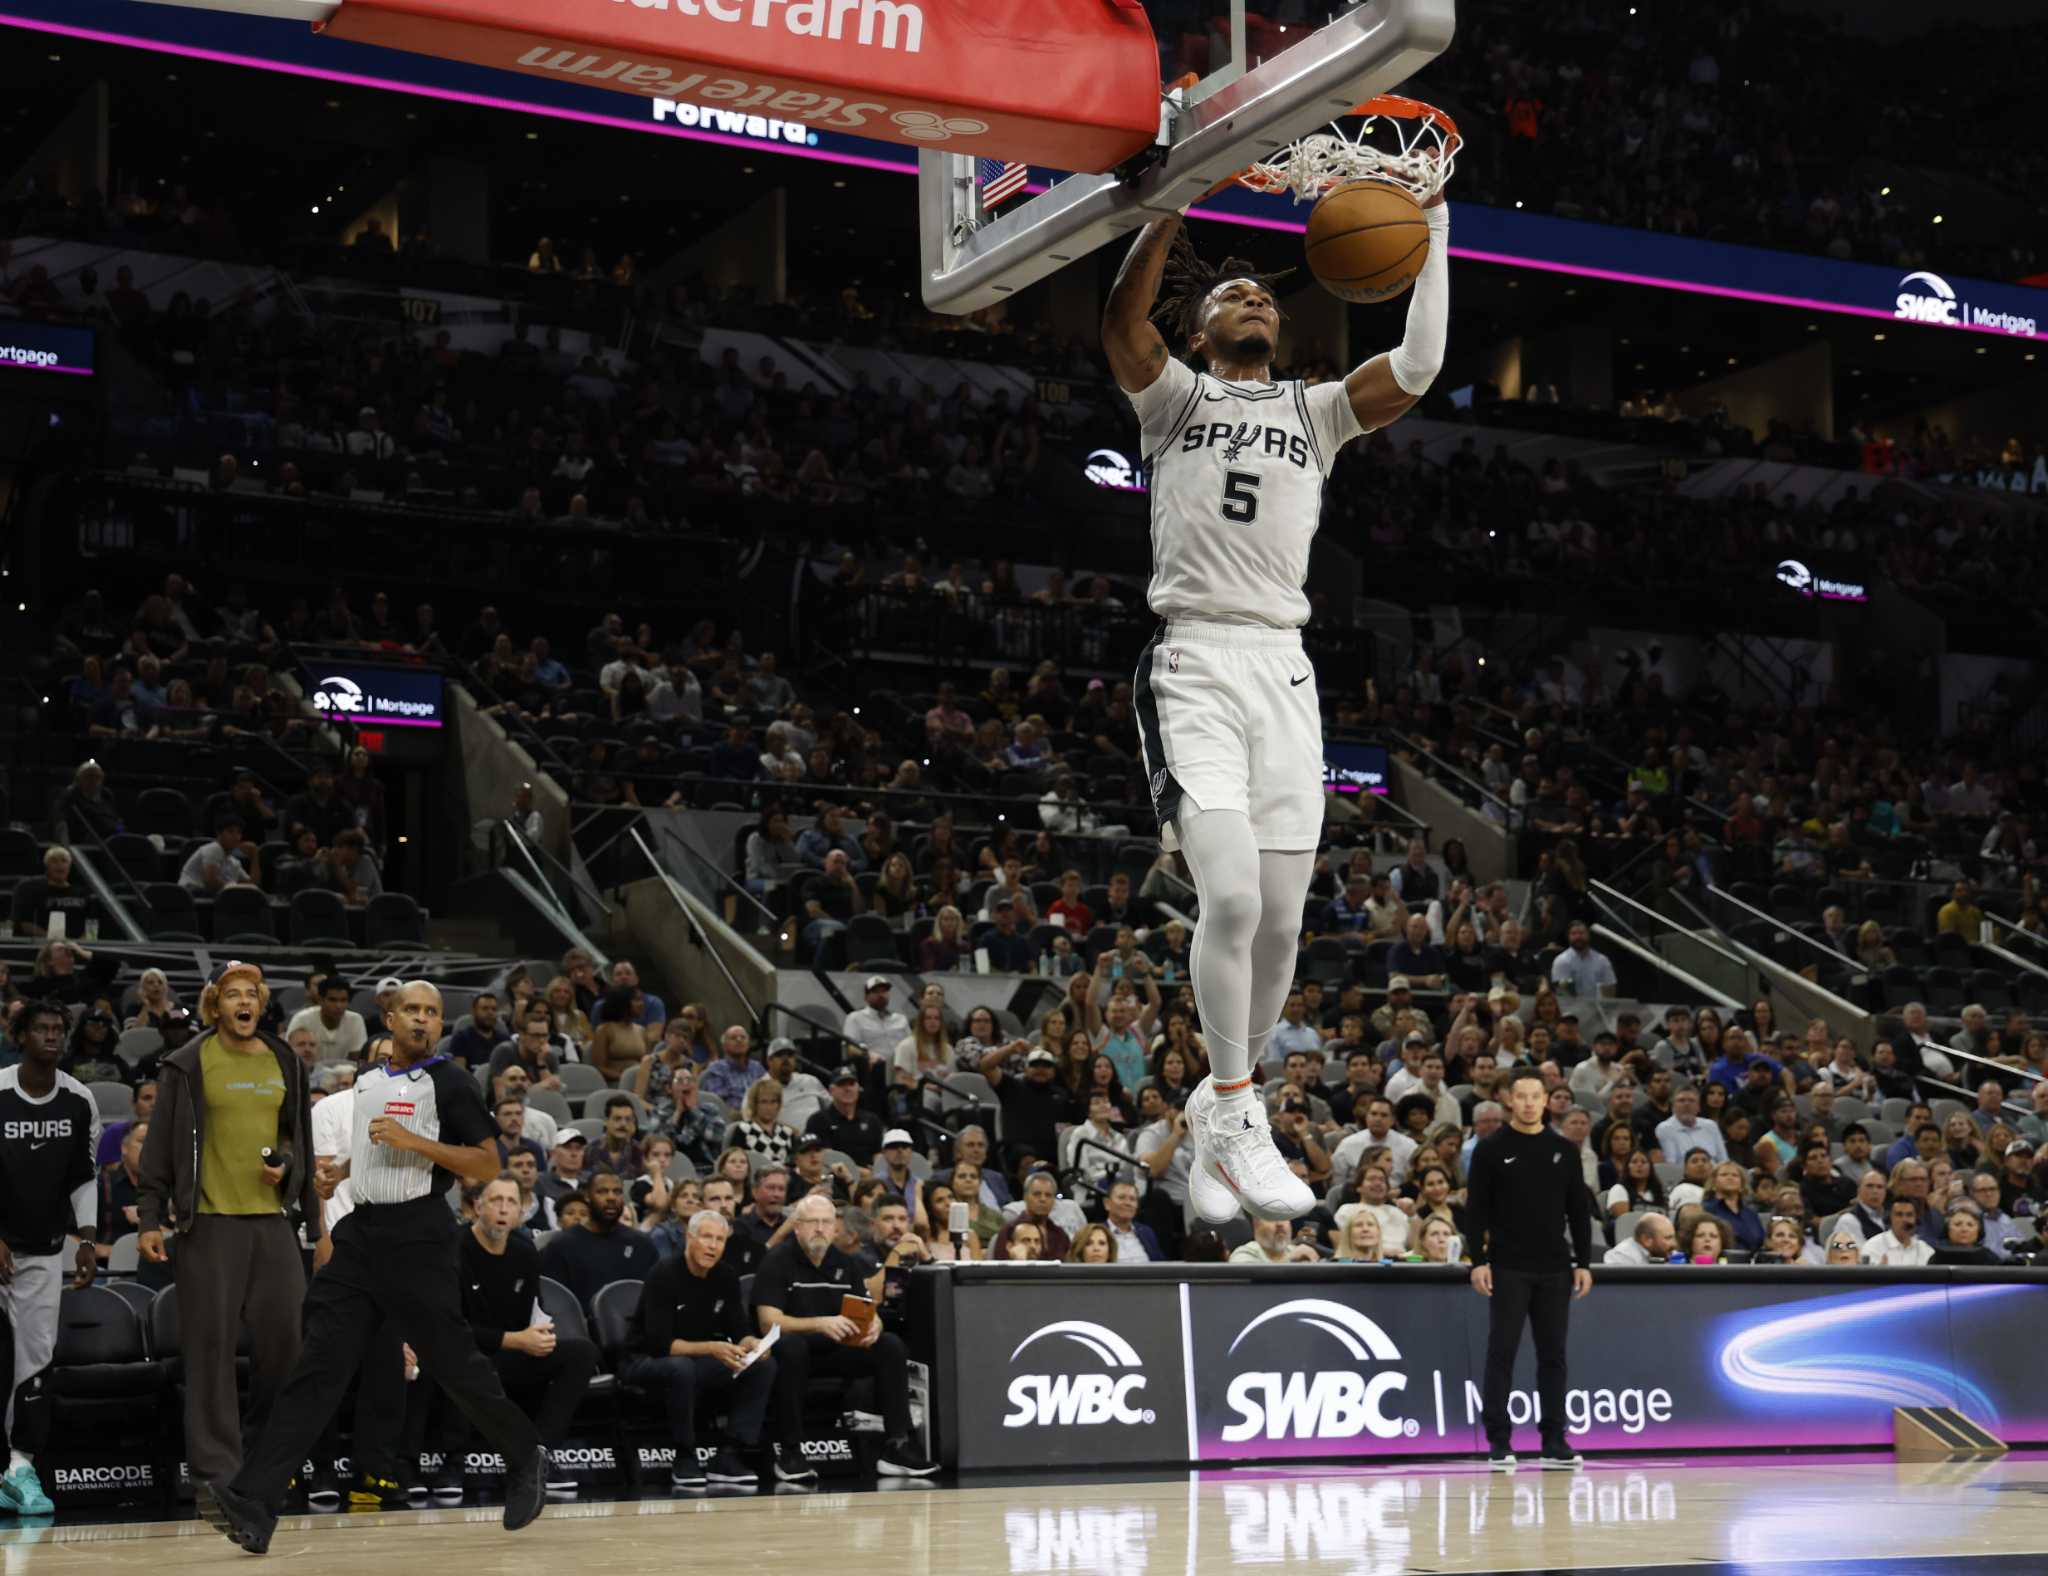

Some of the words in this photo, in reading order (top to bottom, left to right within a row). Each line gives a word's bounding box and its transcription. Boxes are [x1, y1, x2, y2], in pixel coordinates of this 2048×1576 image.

[517, 45, 888, 127] StateFarm
[1894, 293, 1960, 325] SWBC
[1182, 422, 1309, 469] SPURS
[1219, 468, 1262, 526] 5
[376, 698, 435, 716] Mortgage
[4, 1118, 73, 1140] SPURS
[1465, 1380, 1673, 1433] ogage
[419, 1452, 506, 1468] BAODE
[548, 1448, 616, 1463] RCODE
[637, 1446, 718, 1462] BARDE
[55, 1464, 153, 1485] BARCODE
[56, 1481, 122, 1492] PERFORMANCE
[124, 1480, 154, 1489] WATER
